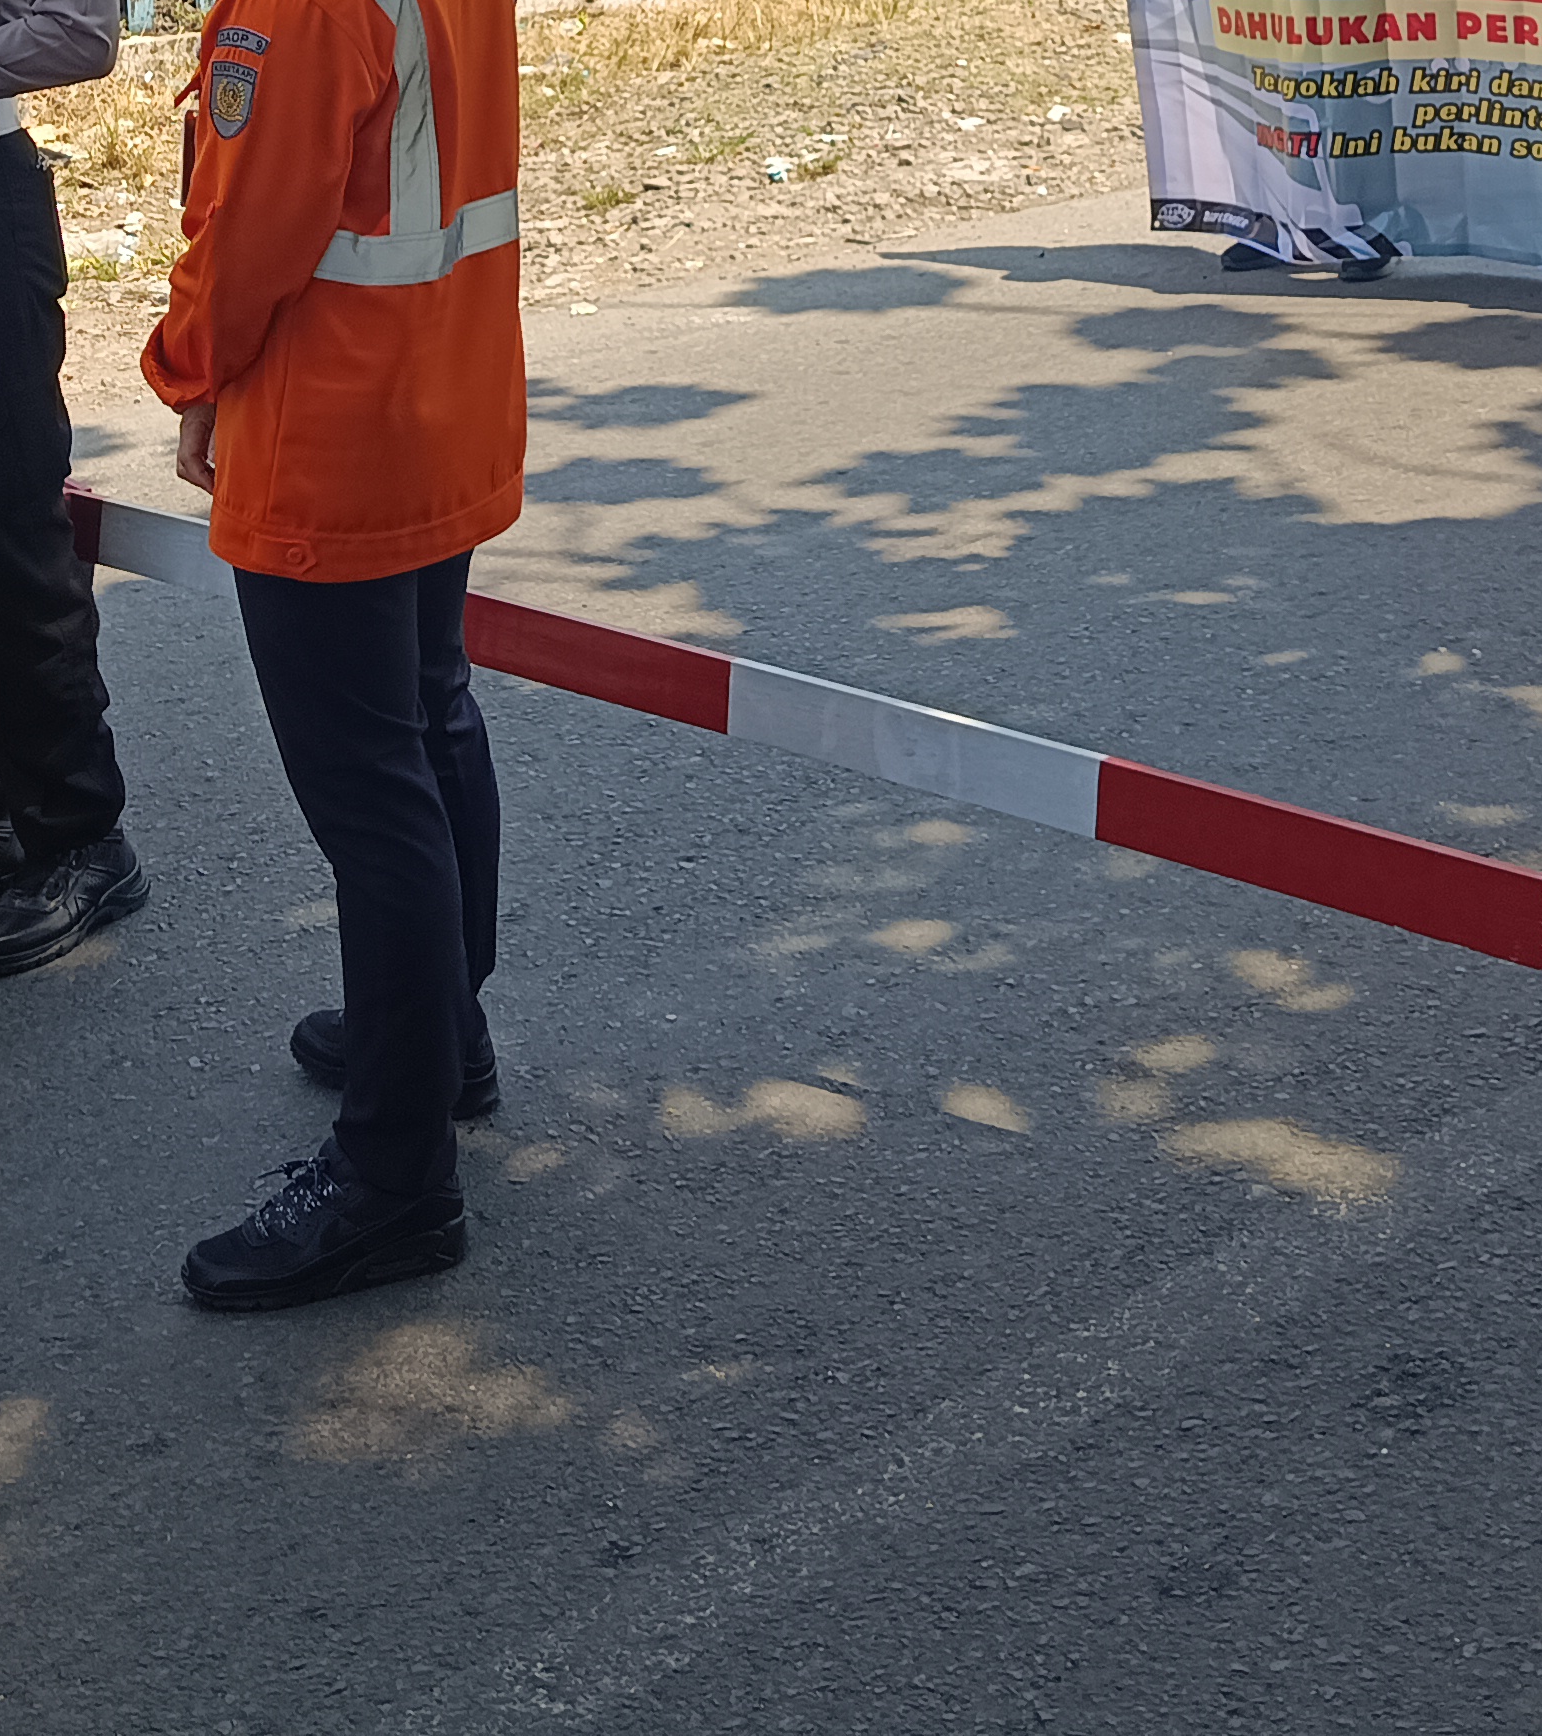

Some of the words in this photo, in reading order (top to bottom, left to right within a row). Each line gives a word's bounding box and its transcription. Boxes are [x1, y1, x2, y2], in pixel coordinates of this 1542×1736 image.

[219, 31, 249, 44] DAOP
[255, 39, 263, 50] 9
[1217, 6, 1437, 46] DAHULUKAN
[1409, 67, 1480, 95] kiri
[1329, 128, 1383, 159] Ini
[1390, 127, 1502, 157] bukan
